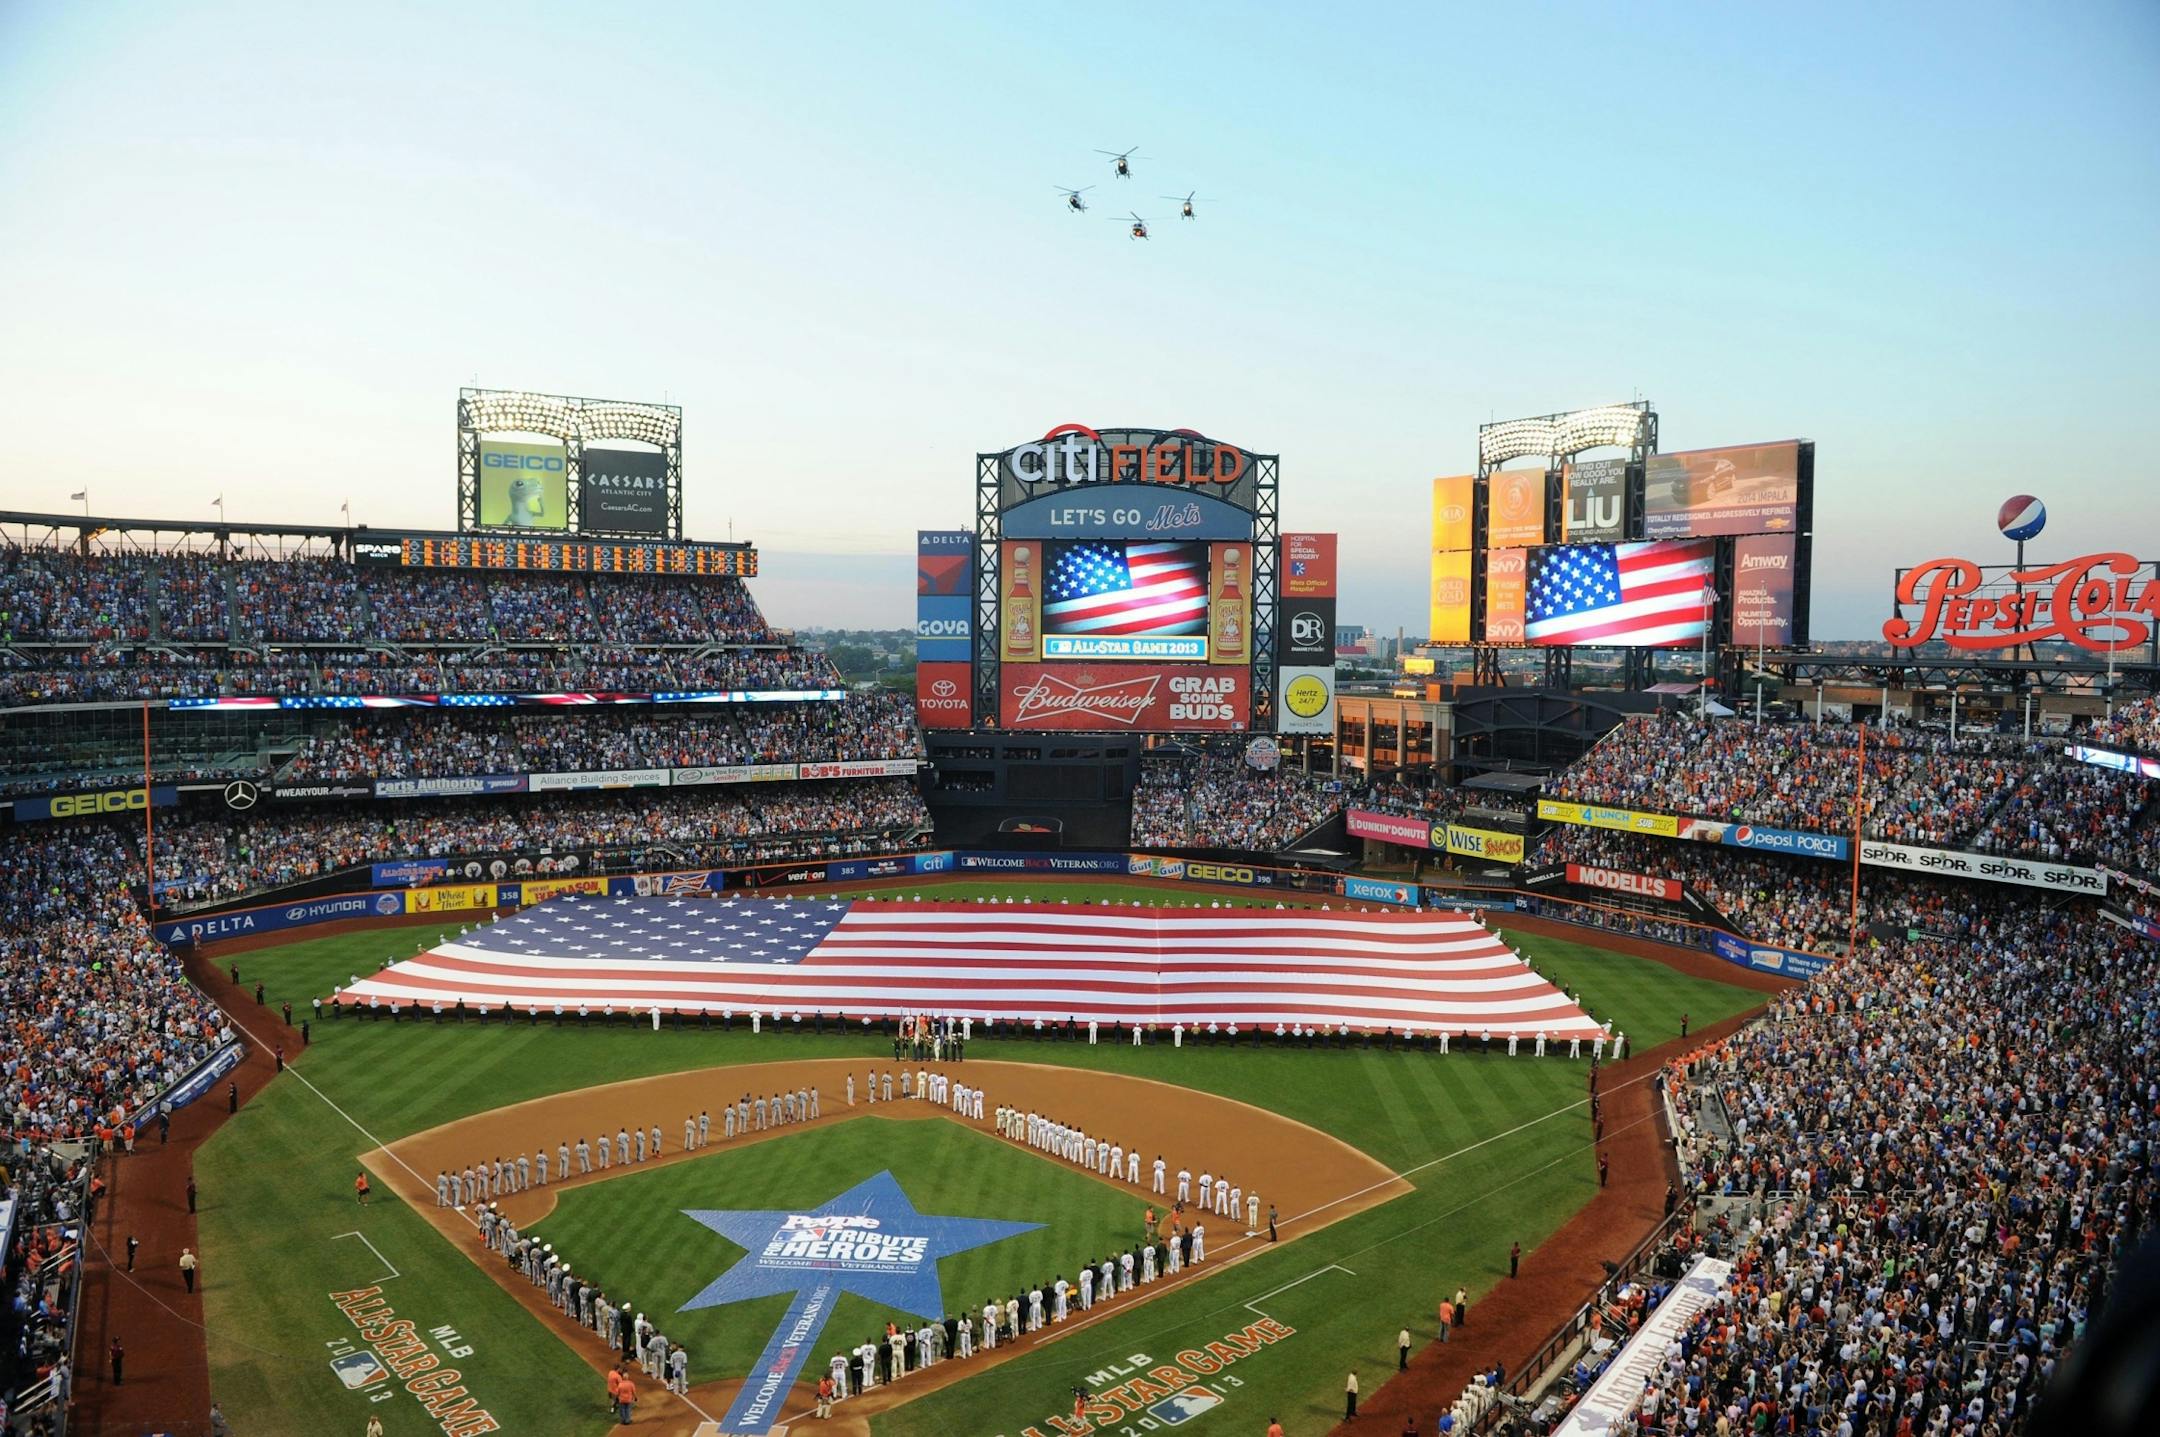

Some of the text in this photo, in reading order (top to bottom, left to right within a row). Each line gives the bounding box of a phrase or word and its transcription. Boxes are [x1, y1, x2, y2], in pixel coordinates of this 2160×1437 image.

[483, 453, 563, 472] GEICO
[1112, 445, 1244, 482] FIELD
[1576, 461, 1612, 471] FIND OUT
[587, 473, 665, 489] CAESARS
[1583, 470, 1607, 478] GOOD
[1607, 468, 1625, 476] YOU
[601, 488, 635, 496] ATLANTIC
[1758, 490, 1788, 501] IMPALA
[601, 502, 653, 512] CaesarsAC.com
[1567, 494, 1620, 529] LIU
[1050, 502, 1201, 530] LET'S GO Mets
[1647, 514, 1671, 523] TOTALLY
[1713, 508, 1761, 519] AGGRESSIVELY
[933, 536, 970, 544] DELTA
[1741, 553, 1788, 569] Amway
[1738, 596, 1777, 604] Products.
[918, 620, 969, 636] GOYA
[1291, 619, 1324, 639] DR
[1738, 617, 1788, 627] Opportunity.
[1133, 641, 1168, 655] GAME
[1169, 642, 1198, 654] 2013
[1169, 677, 1236, 693] GRAB
[919, 699, 969, 709] TOYOTA
[1014, 686, 1157, 710] Budweiser
[1180, 693, 1224, 704] SOME
[1169, 704, 1235, 720] BUDS
[541, 771, 660, 785] Alliance Building Services
[842, 767, 885, 777] FURNITURE
[417, 778, 484, 791] Authority
[50, 789, 148, 818] GEICO
[1594, 808, 1630, 820] LUNCH
[1391, 826, 1427, 840] DONUTS
[1450, 830, 1522, 857] WISE SNACKS
[1755, 833, 1837, 852] pepsi PORCH
[841, 867, 855, 875] 385
[923, 856, 943, 870] citi
[1130, 860, 1184, 876] Gulf Gulf
[788, 870, 826, 881] verizon
[1187, 863, 1271, 884] GEICO 390
[1580, 866, 1666, 898] MODELL'S
[437, 889, 465, 900] Wheat
[501, 892, 518, 900] 358
[1353, 884, 1392, 899] xerox
[310, 900, 366, 918] HYUNDAI
[192, 915, 255, 936] DELTA
[1788, 956, 1821, 969] Where do
[1788, 965, 1813, 976] want to
[781, 1215, 880, 1231] People
[827, 1229, 929, 1249] TRIBUTE
[763, 1241, 925, 1263] FOR HEROES
[429, 1324, 475, 1359] MLB
[1176, 1316, 1297, 1375] GAME
[1084, 1352, 1153, 1388] MLB
[405, 1368, 501, 1437] GAME
